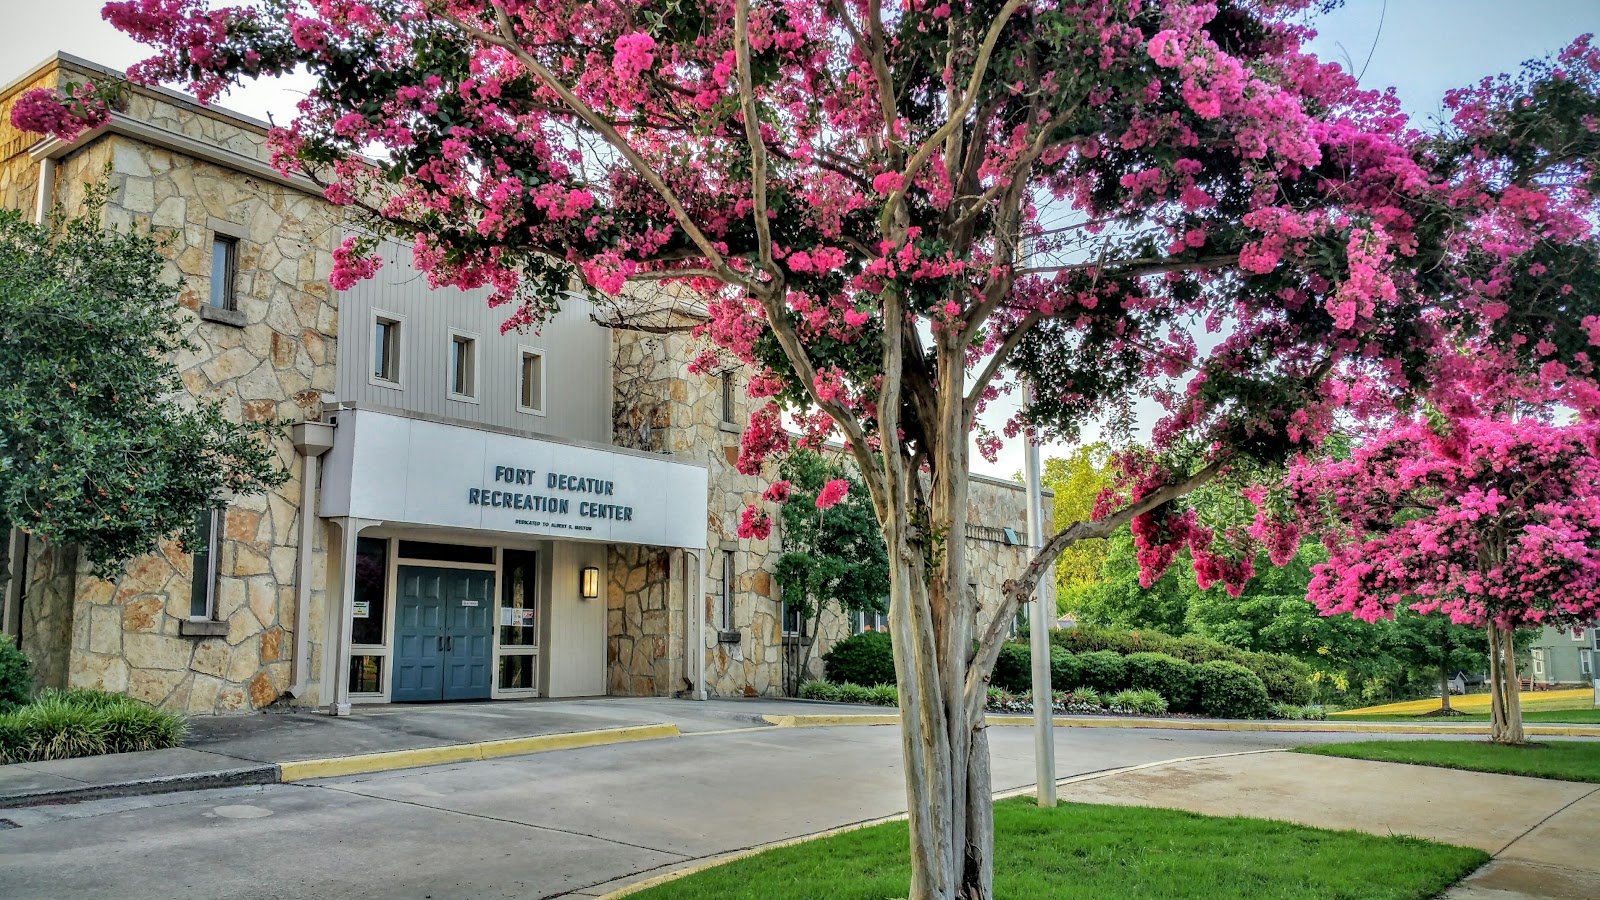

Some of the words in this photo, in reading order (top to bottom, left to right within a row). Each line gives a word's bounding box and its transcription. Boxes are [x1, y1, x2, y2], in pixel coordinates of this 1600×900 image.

[495, 465, 536, 486] FORT
[547, 472, 614, 496] DECATUR
[469, 487, 569, 514] RECREATION
[579, 501, 633, 521] CENTER
[515, 519, 541, 527] DEDICATED
